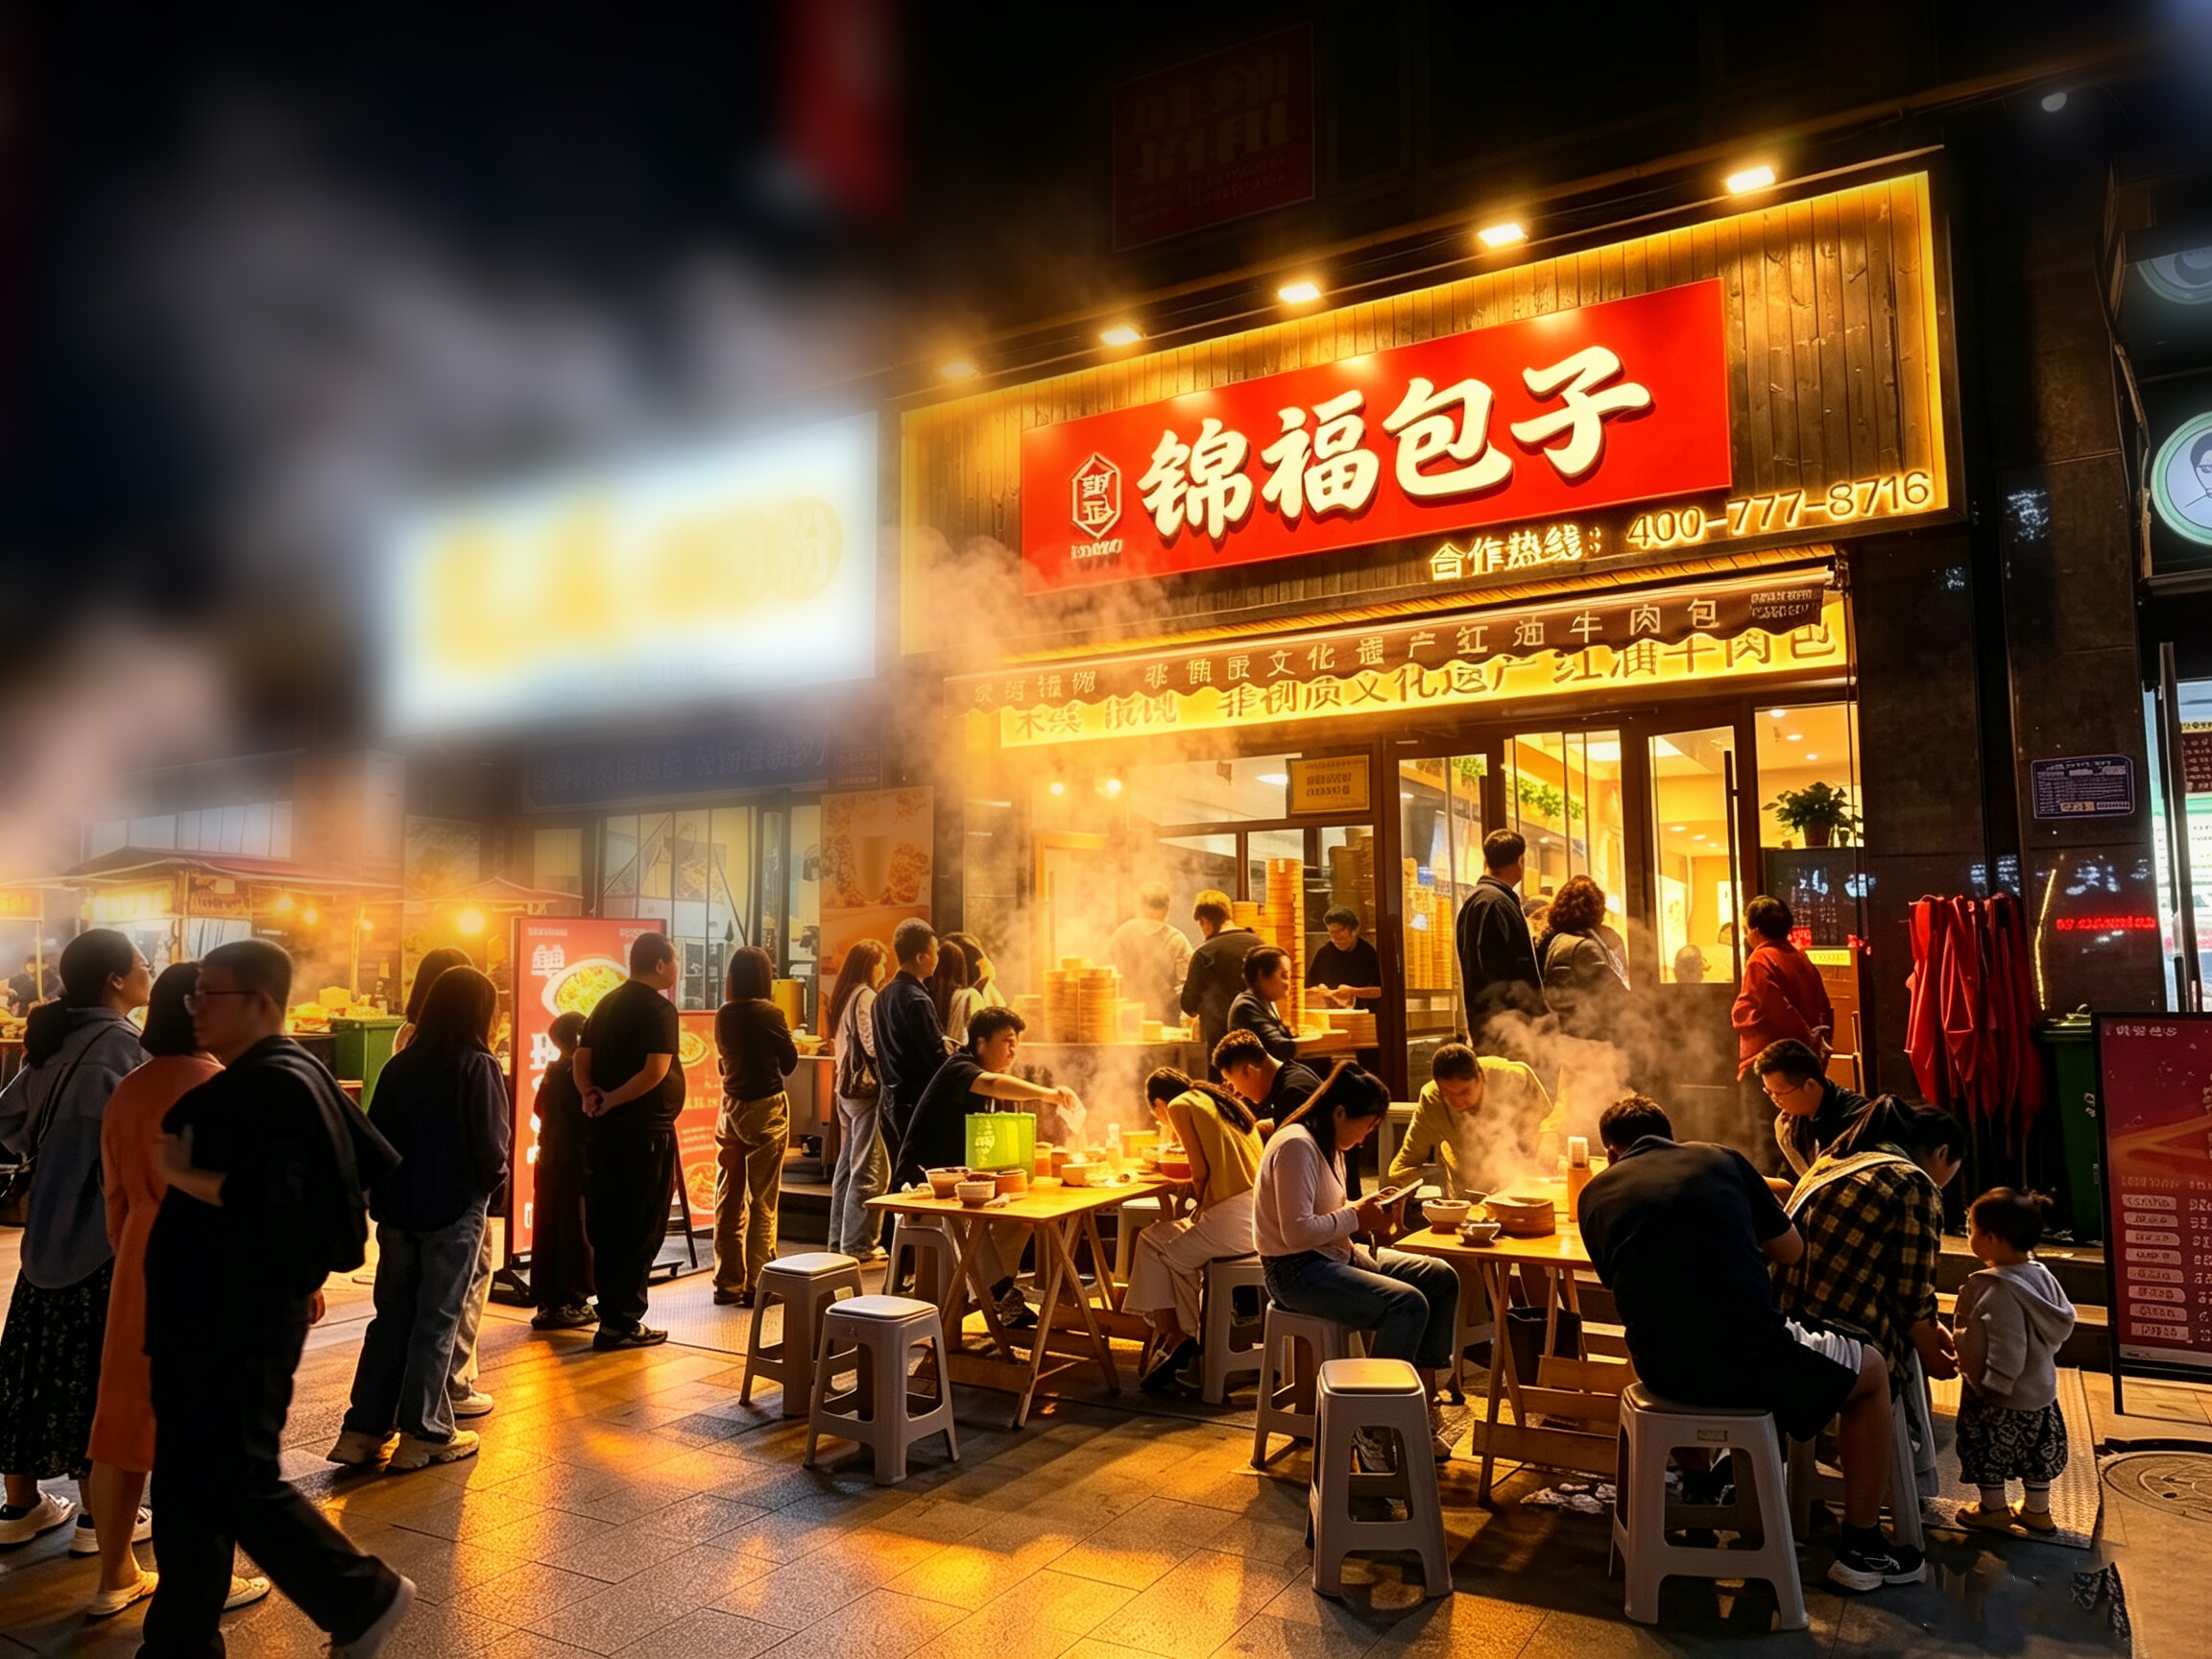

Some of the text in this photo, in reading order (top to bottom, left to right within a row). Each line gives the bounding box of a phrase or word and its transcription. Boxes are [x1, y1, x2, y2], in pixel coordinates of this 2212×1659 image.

[1137, 345, 1651, 541] 锦福包子
[1625, 469, 1931, 550] 400-777-8716
